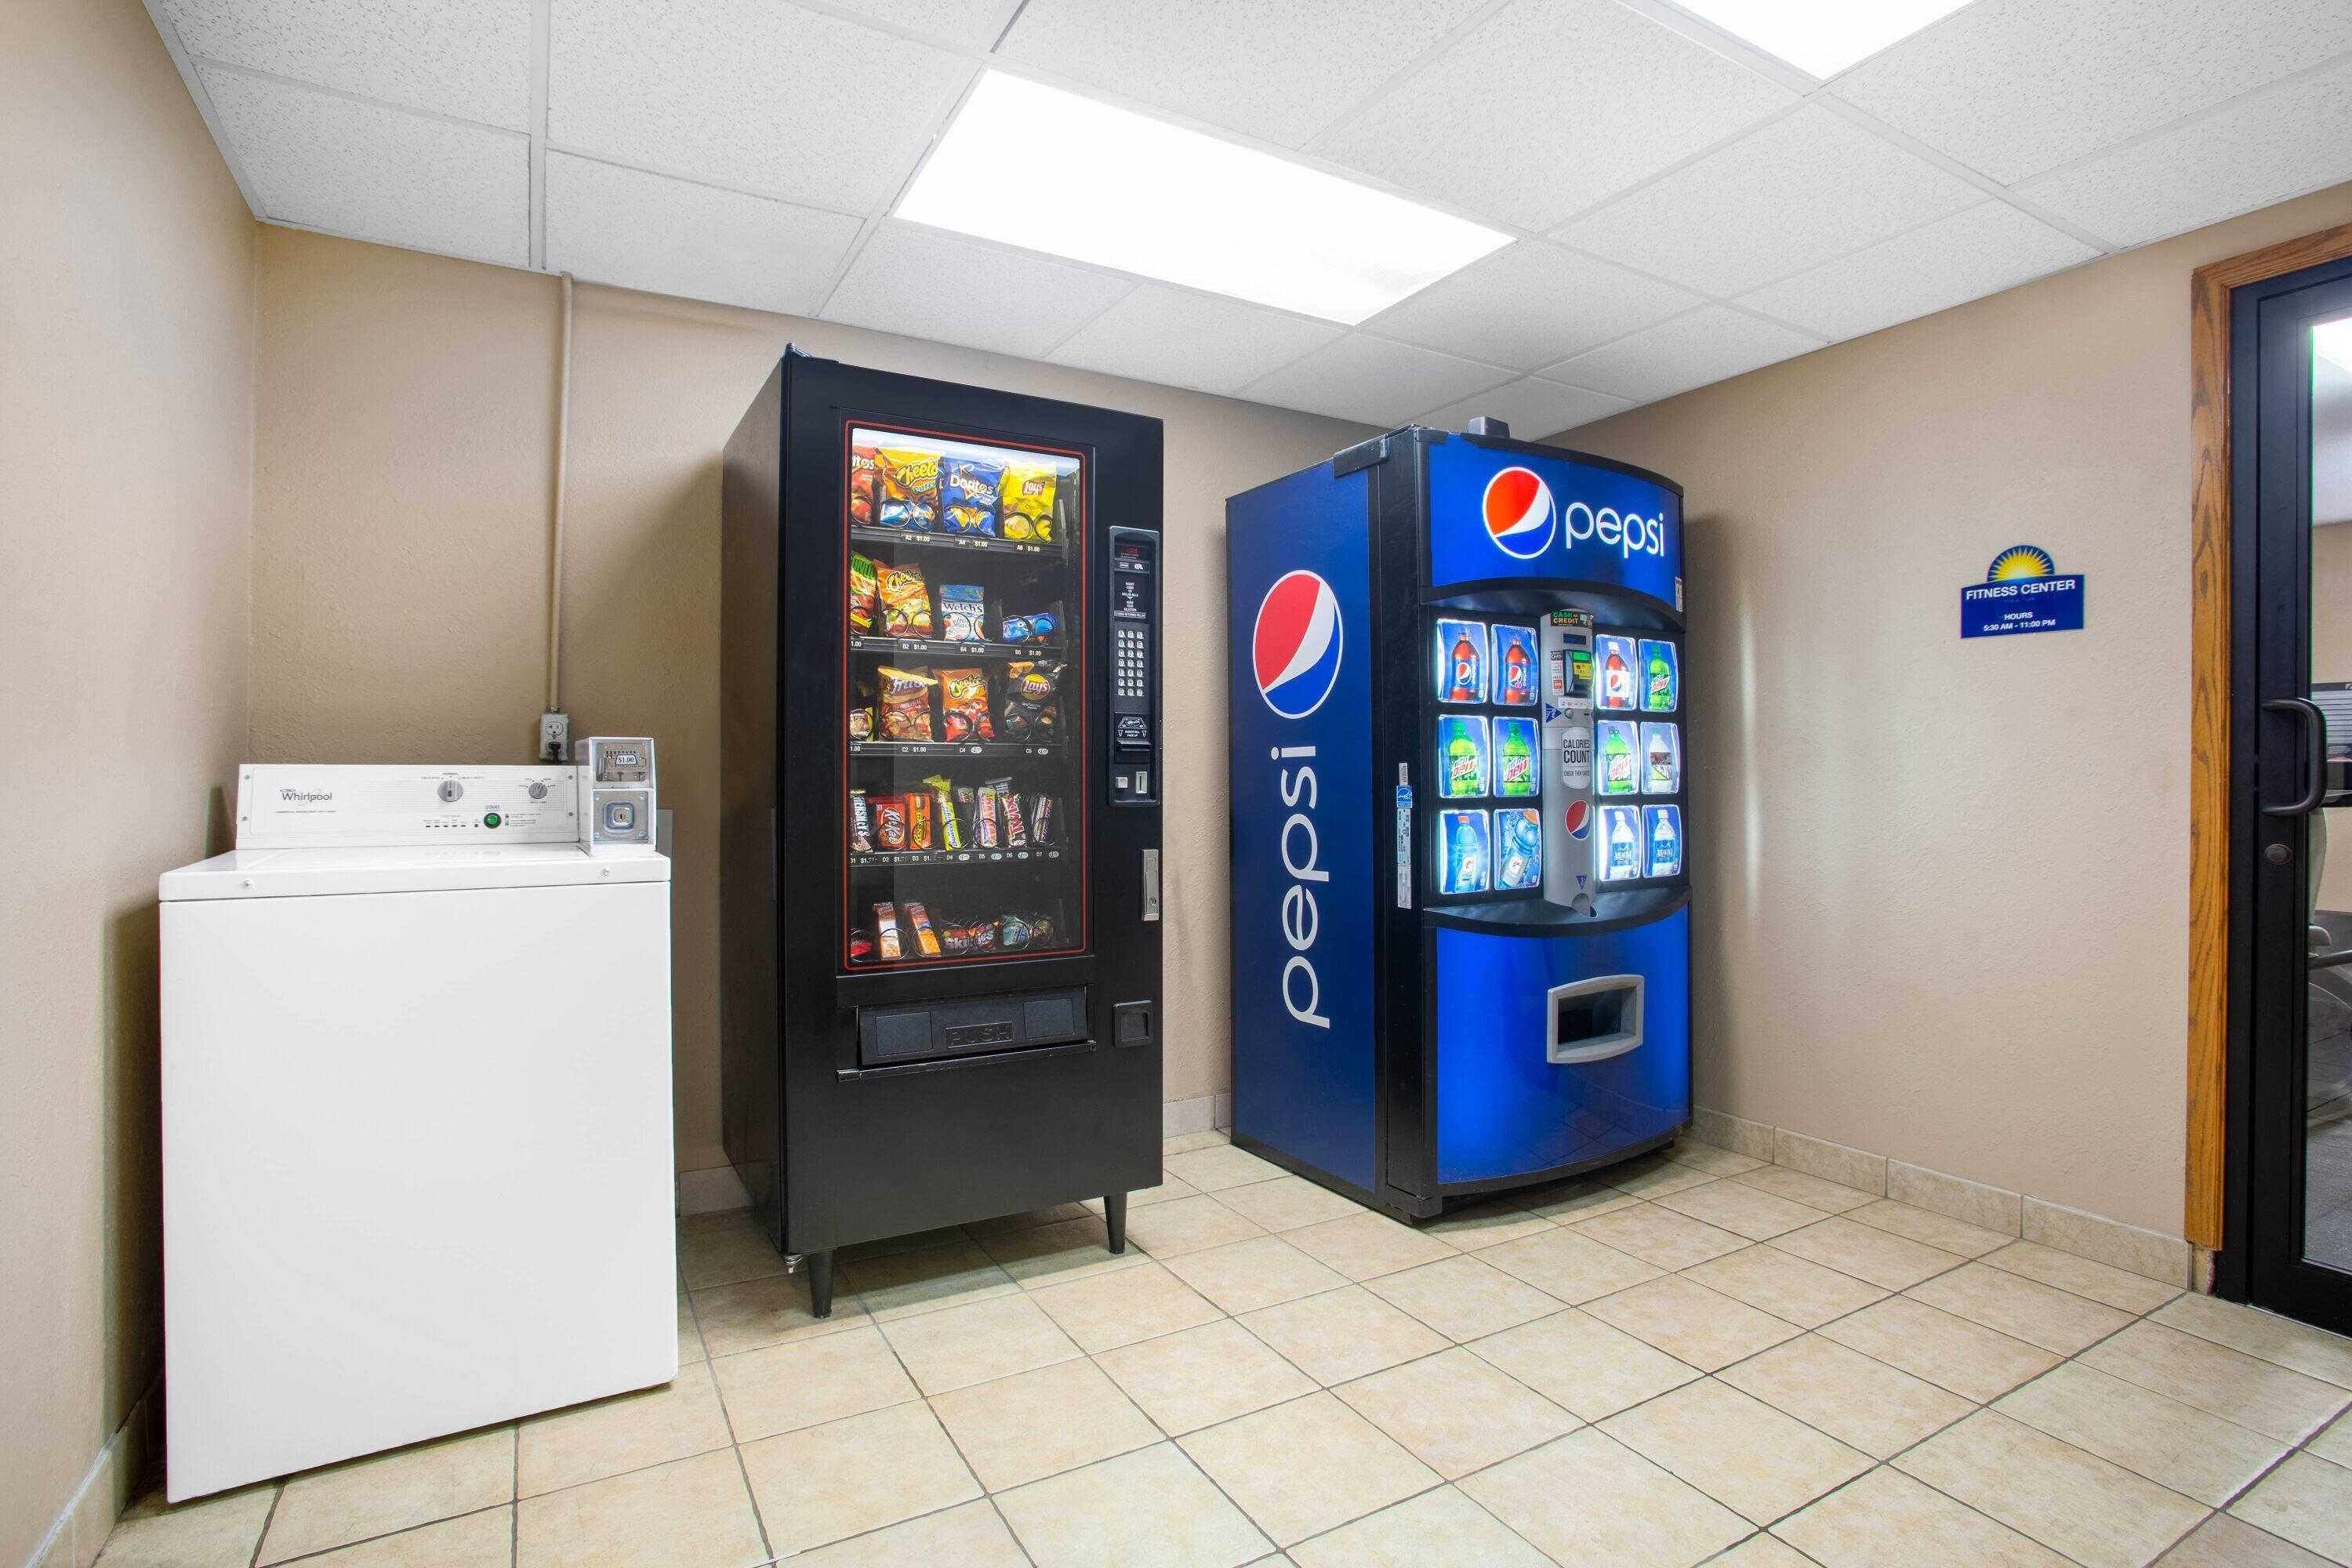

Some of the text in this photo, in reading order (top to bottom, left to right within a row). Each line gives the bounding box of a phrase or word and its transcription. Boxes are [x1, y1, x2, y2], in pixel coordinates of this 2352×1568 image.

[852, 455, 874, 470] itos
[895, 460, 938, 486] Cheeto
[949, 474, 993, 495] Doritos
[1566, 502, 1664, 559] pepsi
[1965, 579, 2075, 600] FITNESS CENTER
[942, 602, 983, 613] Welch's
[2004, 612, 2033, 620] HOURS
[1563, 739, 1590, 749] CALORIES
[1563, 750, 1590, 764] COUNT
[281, 792, 332, 803] Whirlpool
[1007, 797, 1025, 840] TWIX
[1271, 746, 1330, 1029] pepsi
[950, 1027, 1009, 1046] PUSH
